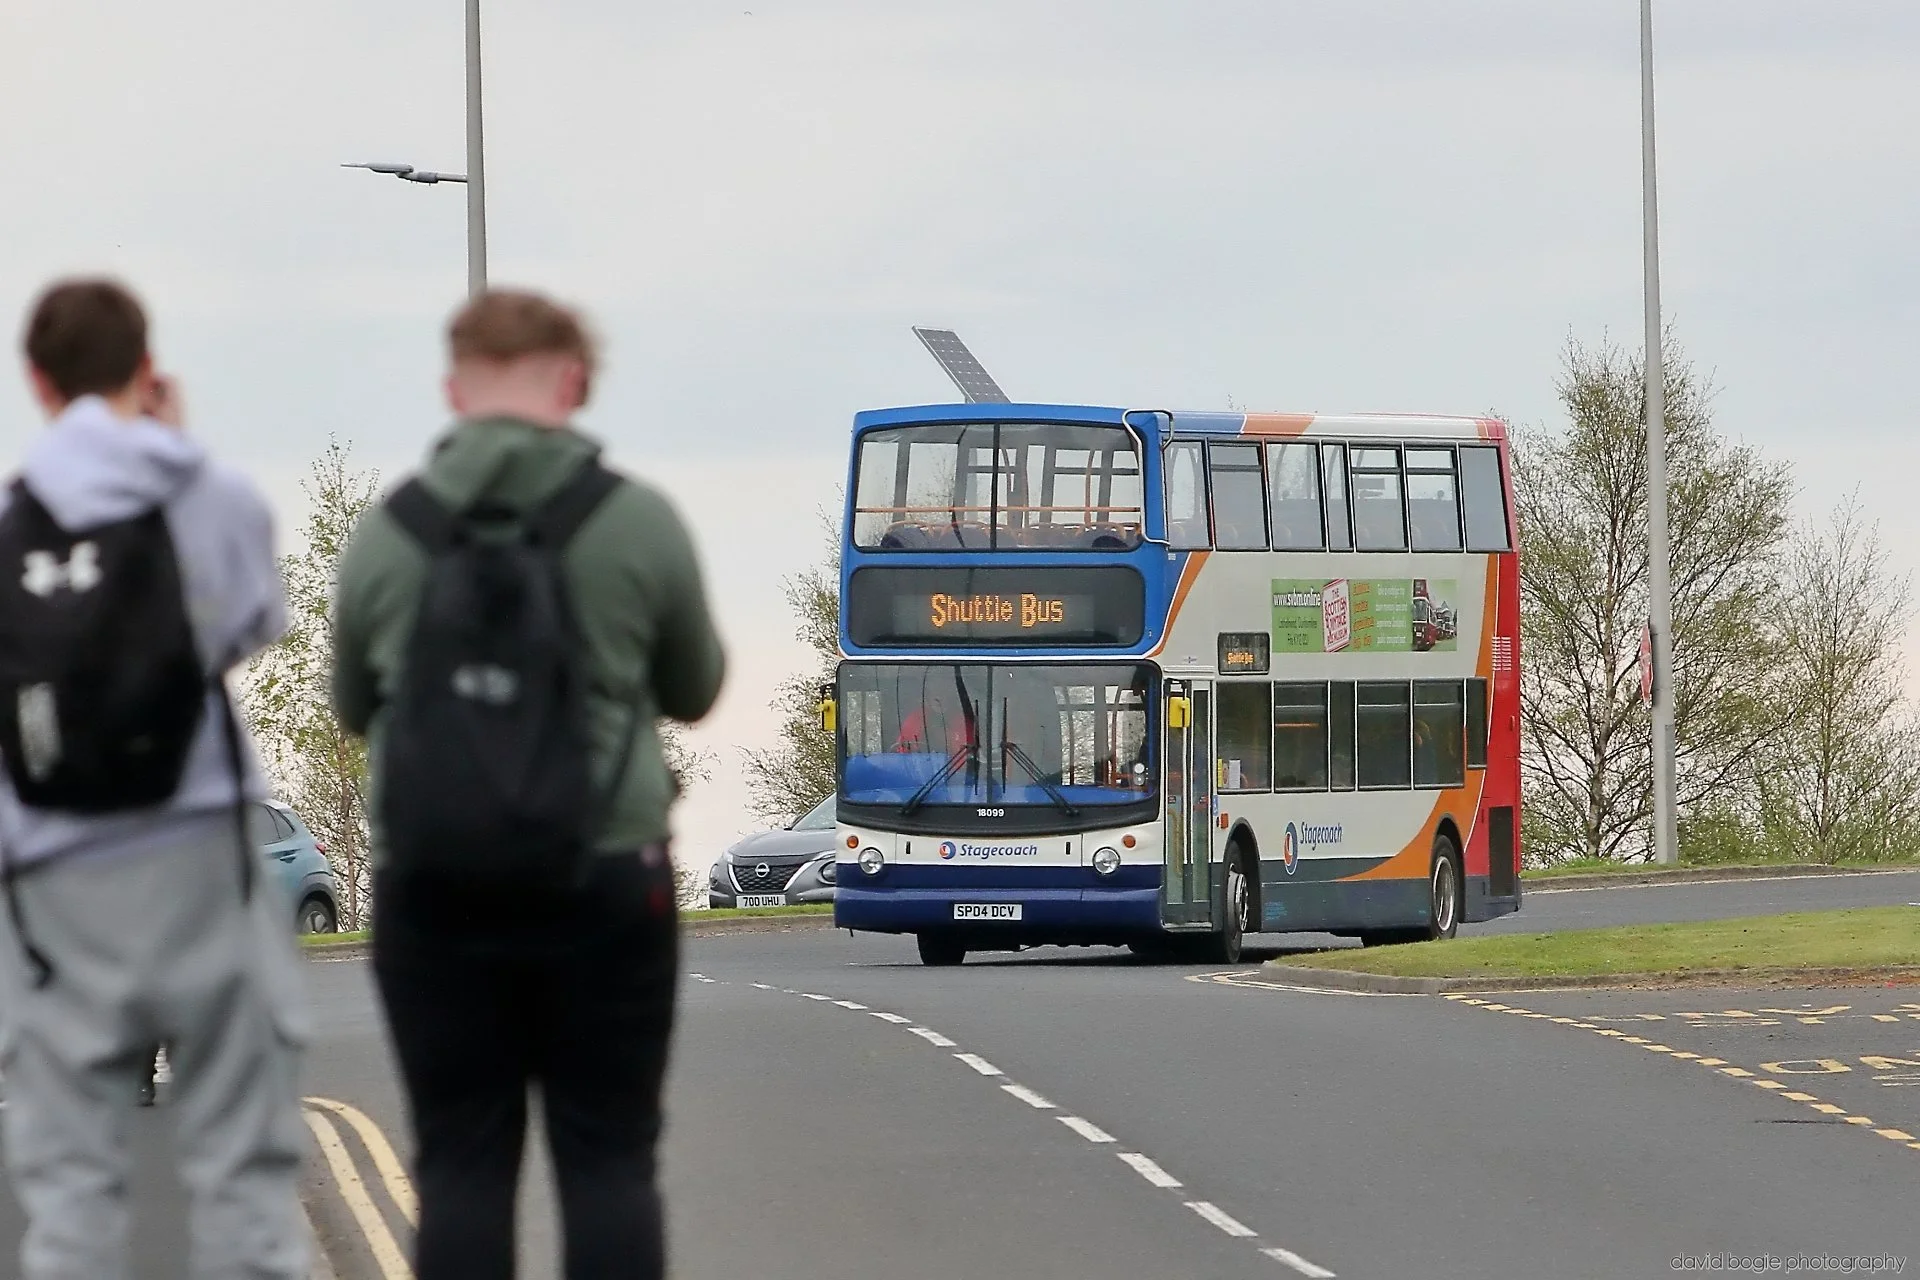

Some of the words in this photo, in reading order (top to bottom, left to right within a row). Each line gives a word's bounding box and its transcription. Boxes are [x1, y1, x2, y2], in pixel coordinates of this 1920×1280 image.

[931, 593, 1013, 627] Shuttle
[1021, 593, 1063, 627] Bus
[976, 808, 1005, 817] 18099
[1300, 821, 1342, 851] Stagecoach
[960, 844, 1037, 860] Stagecoach
[743, 896, 760, 907] 700
[761, 896, 779, 906] UHU
[957, 905, 988, 917] SP04
[991, 905, 1015, 917] DCV
